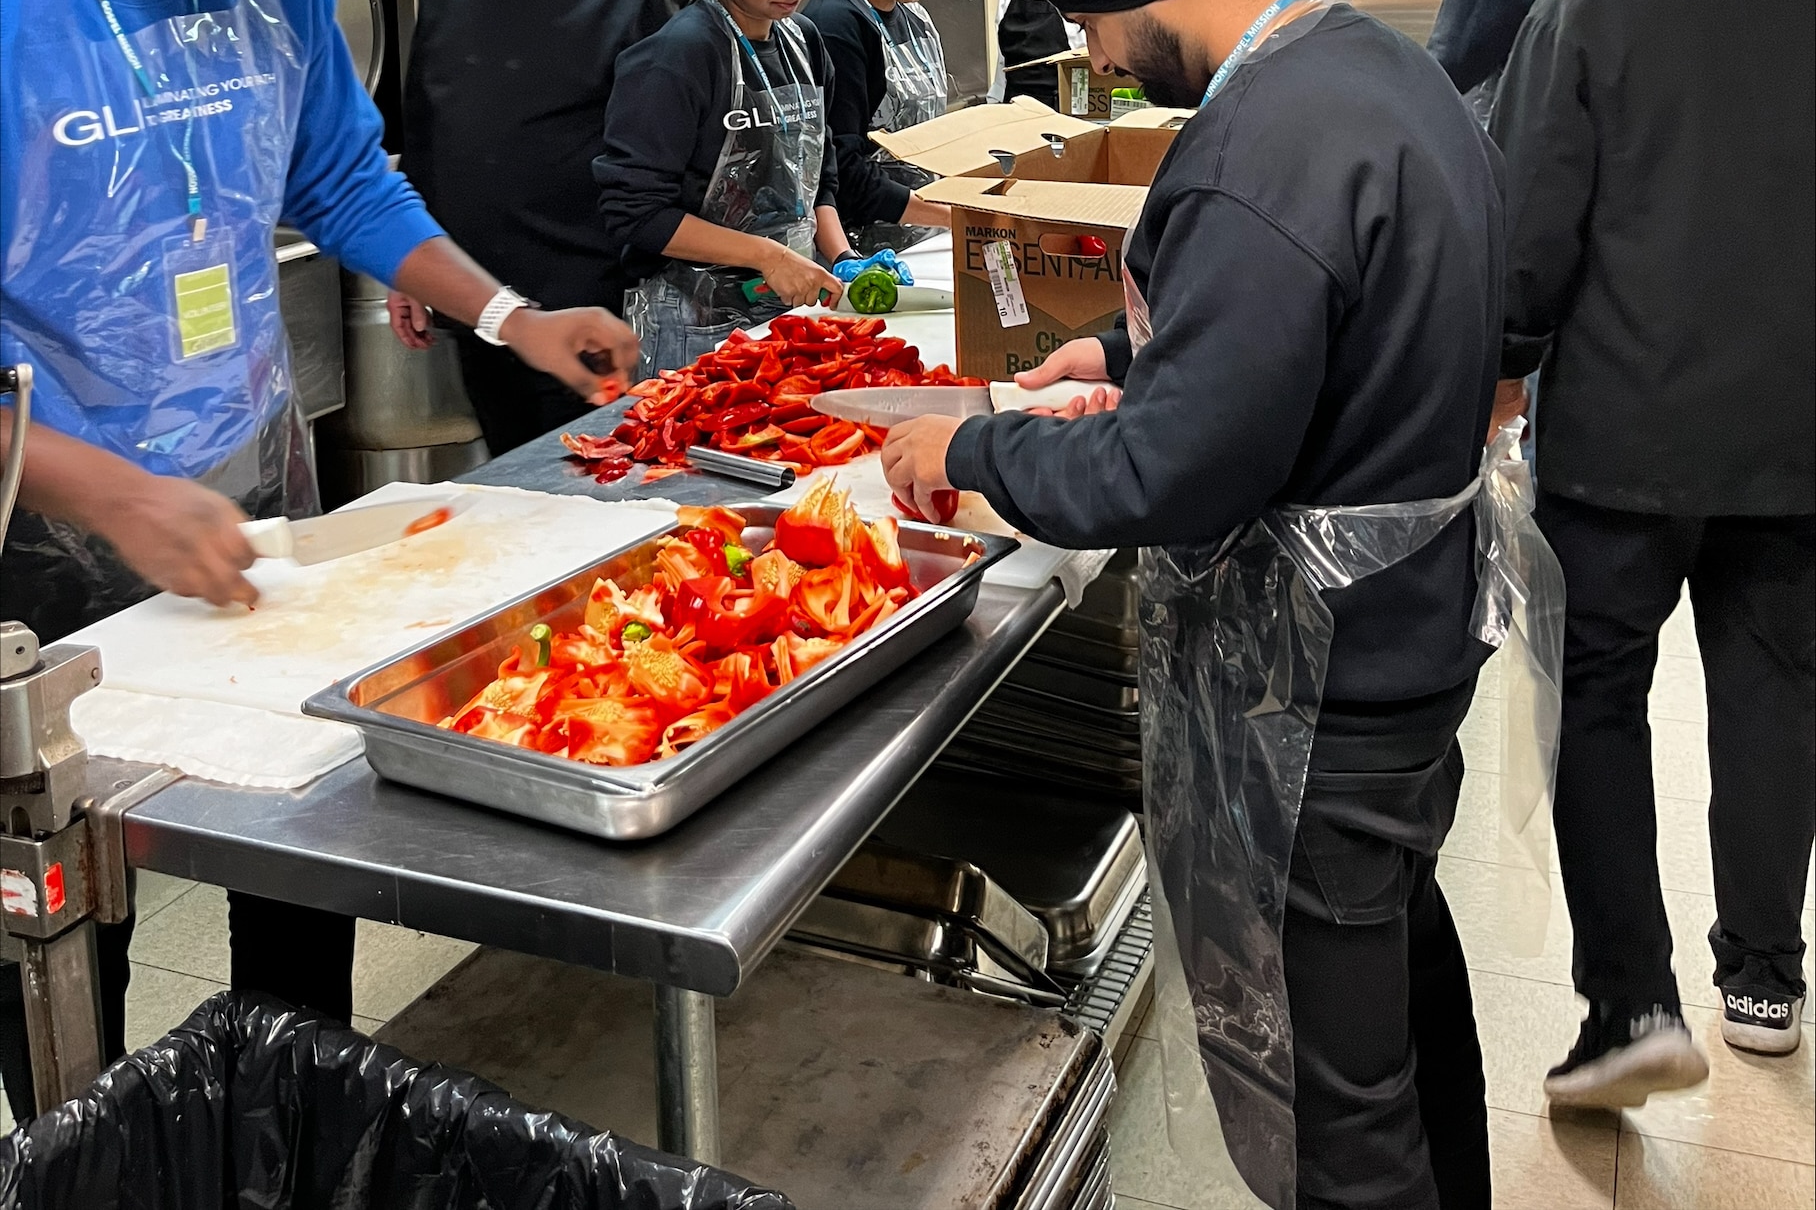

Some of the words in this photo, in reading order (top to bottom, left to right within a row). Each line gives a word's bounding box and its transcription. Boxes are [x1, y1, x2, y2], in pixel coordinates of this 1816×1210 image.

[1206, 67, 1228, 98] UNION
[1224, 36, 1251, 69] GOSPEL
[1247, 3, 1281, 38] MISSION
[784, 110, 817, 124] GREAESS
[966, 225, 1016, 239] MARKON
[1727, 994, 1789, 1019] adidas
